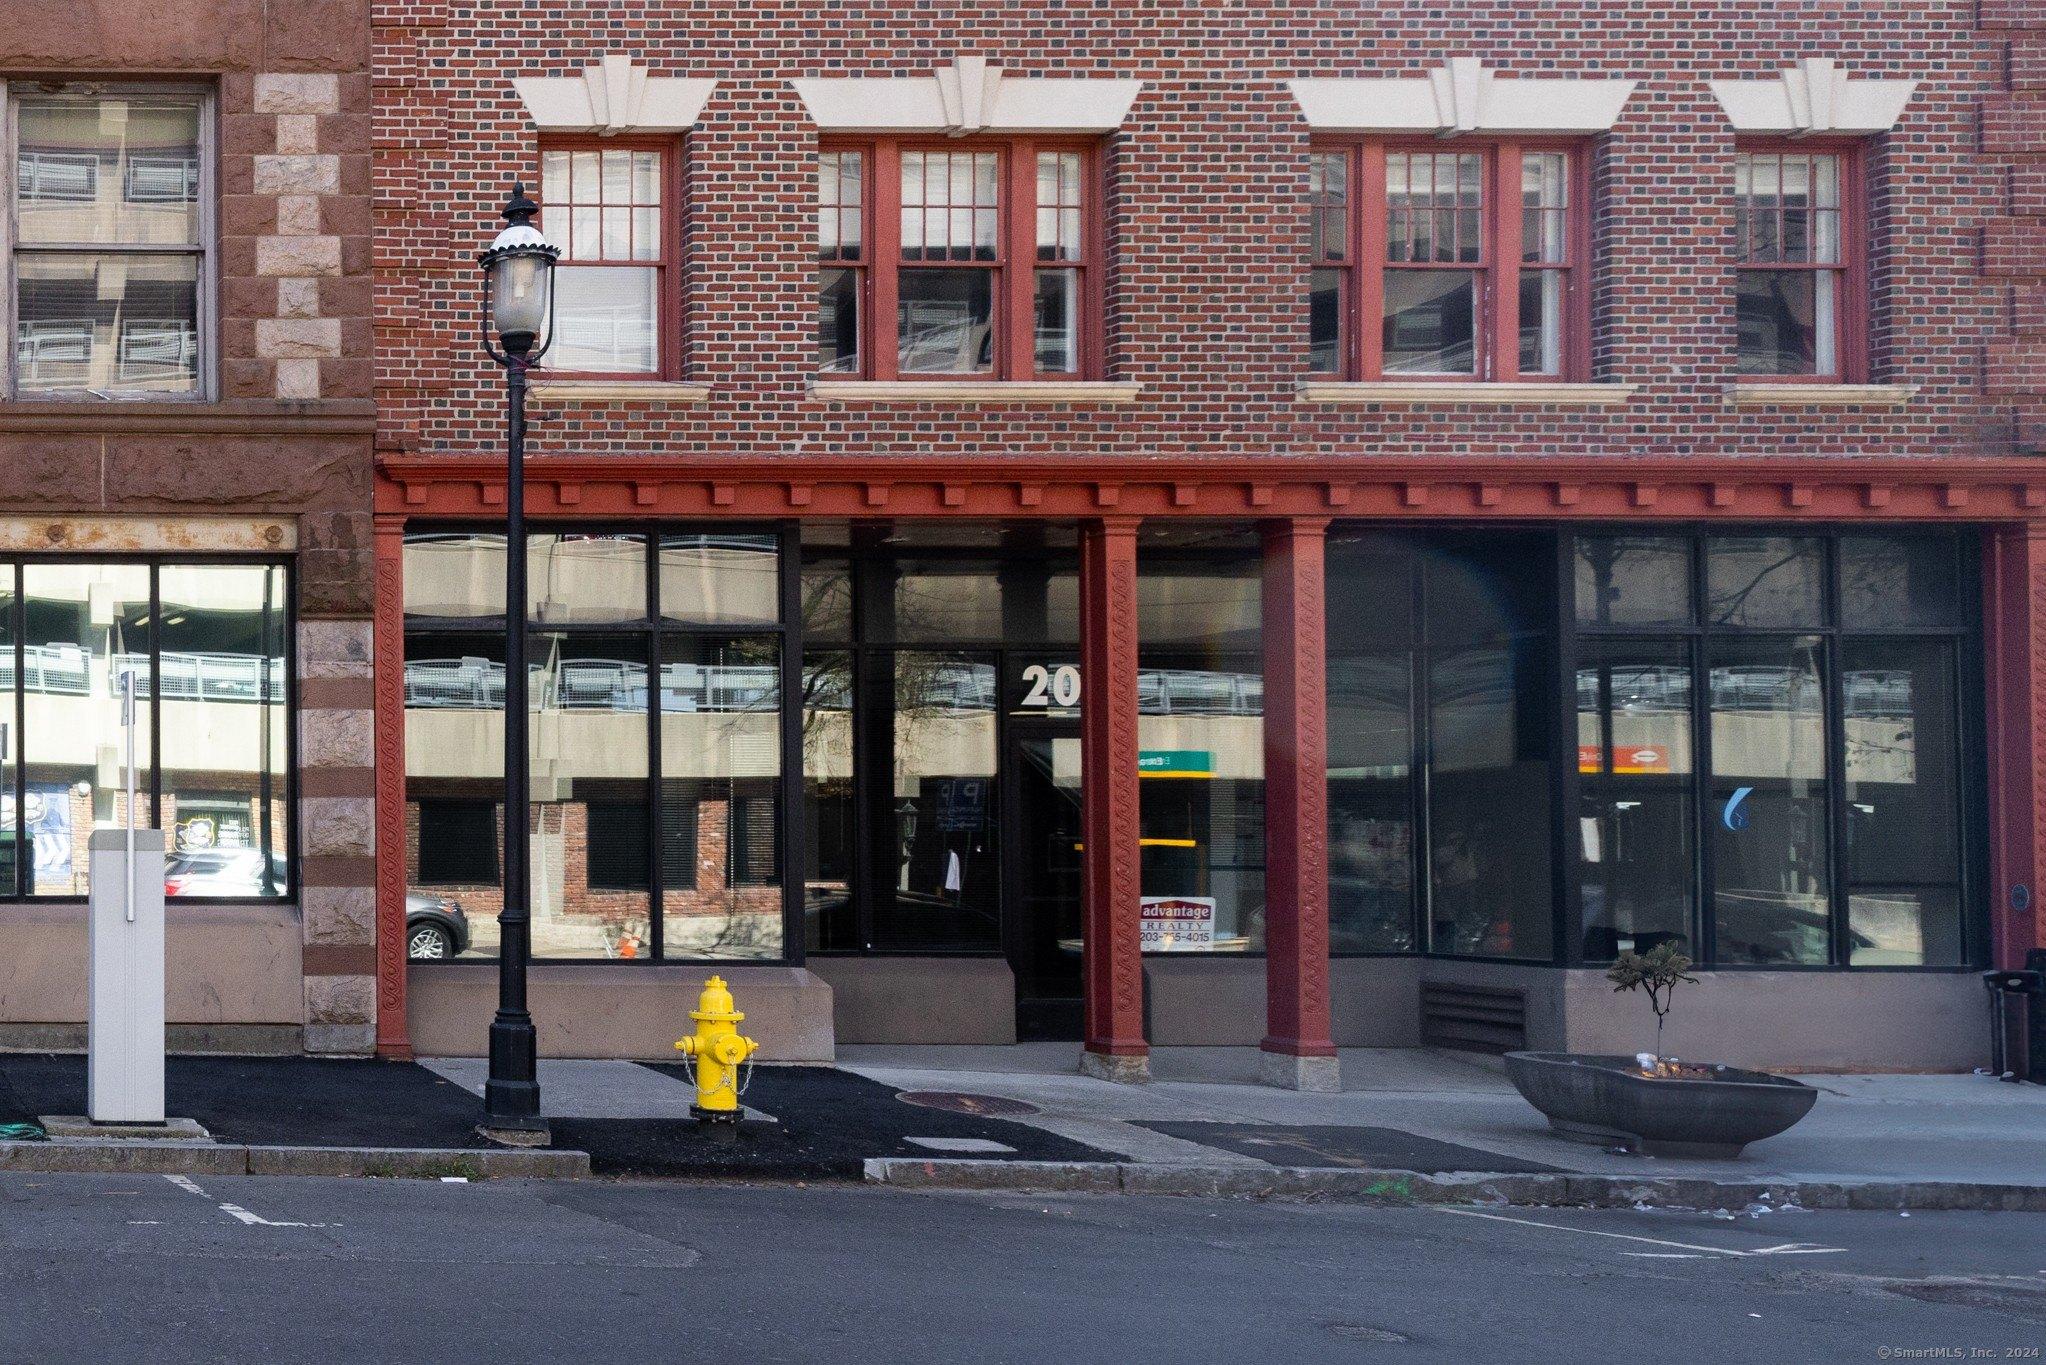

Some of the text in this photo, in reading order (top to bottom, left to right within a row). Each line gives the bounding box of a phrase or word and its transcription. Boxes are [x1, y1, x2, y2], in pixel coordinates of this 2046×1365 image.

[1021, 664, 1081, 706] 20
[1143, 904, 1209, 919] advantage
[1147, 922, 1203, 930] REALTY
